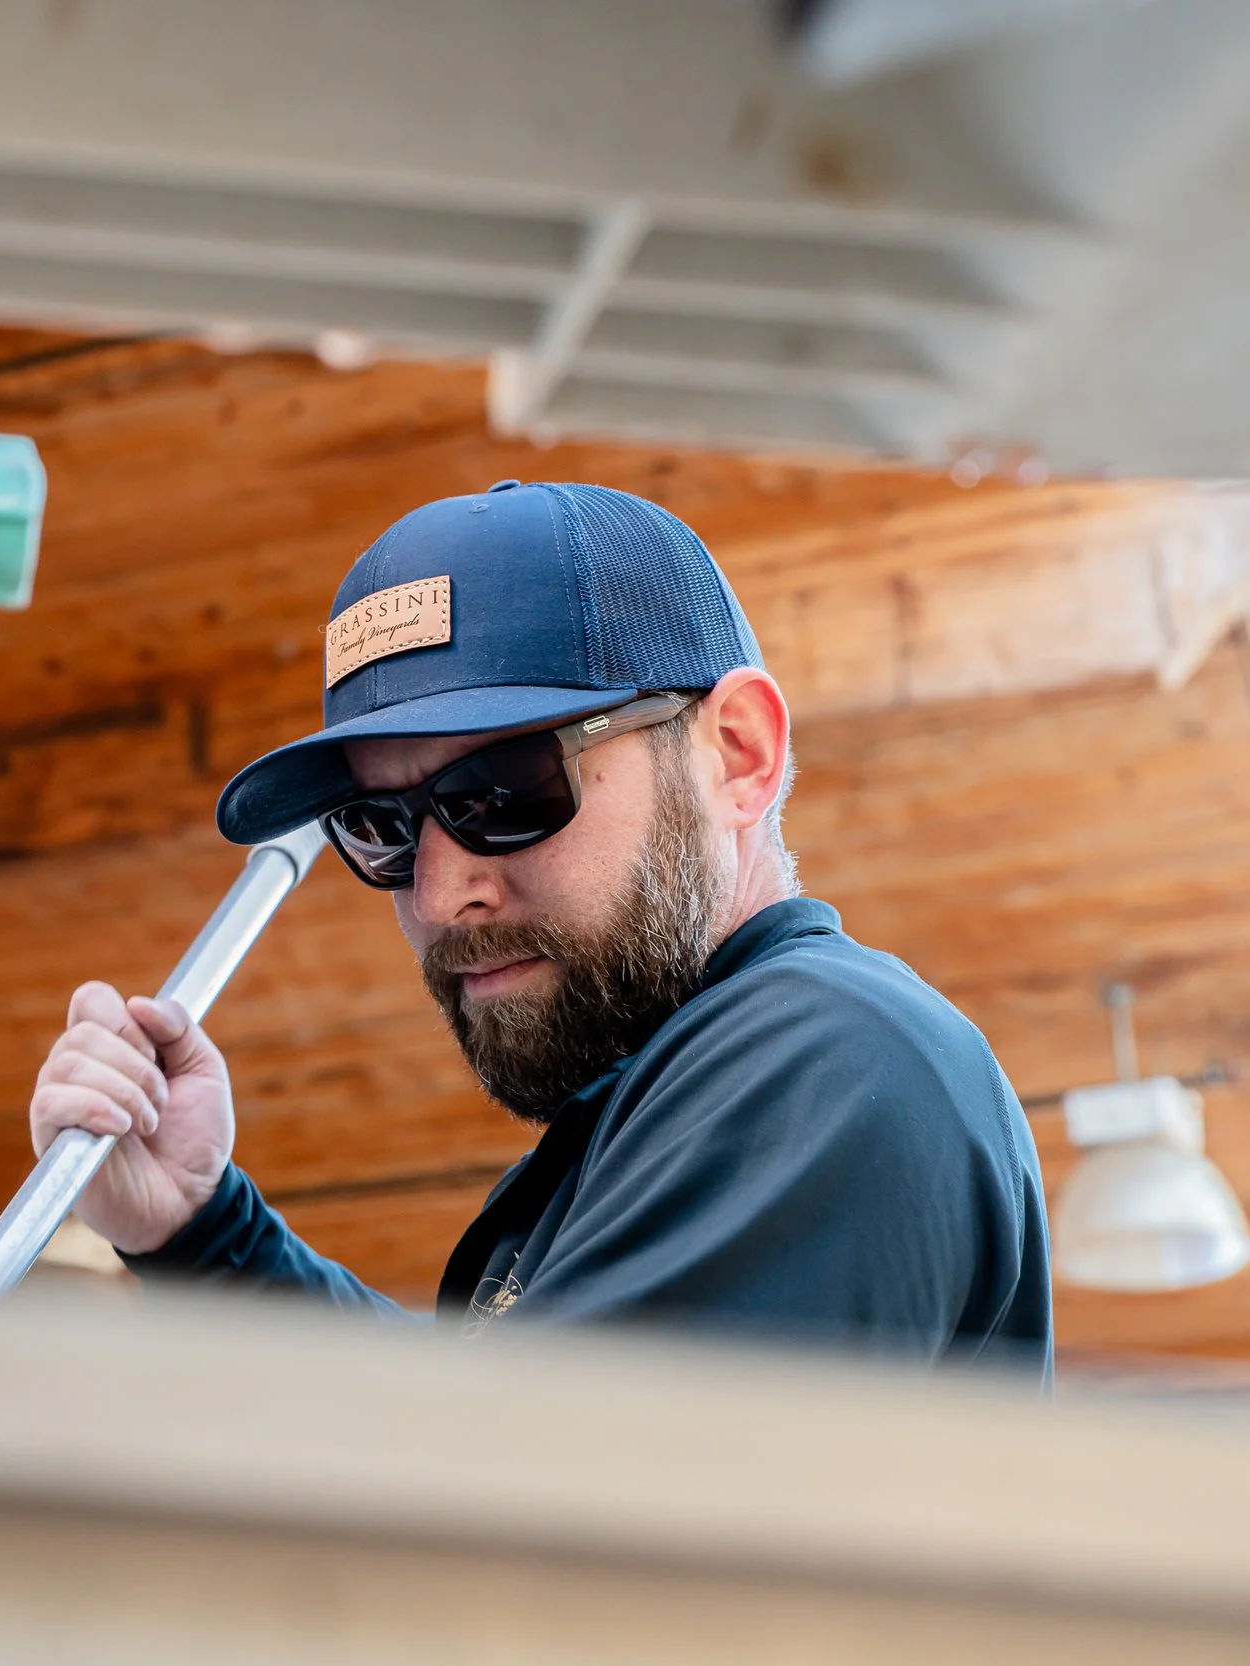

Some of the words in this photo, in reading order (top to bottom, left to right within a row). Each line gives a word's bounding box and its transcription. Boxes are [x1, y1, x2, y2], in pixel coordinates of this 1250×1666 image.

[330, 590, 439, 645] GRASSINI
[337, 627, 366, 657] Family
[367, 613, 420, 641] Vineyards
